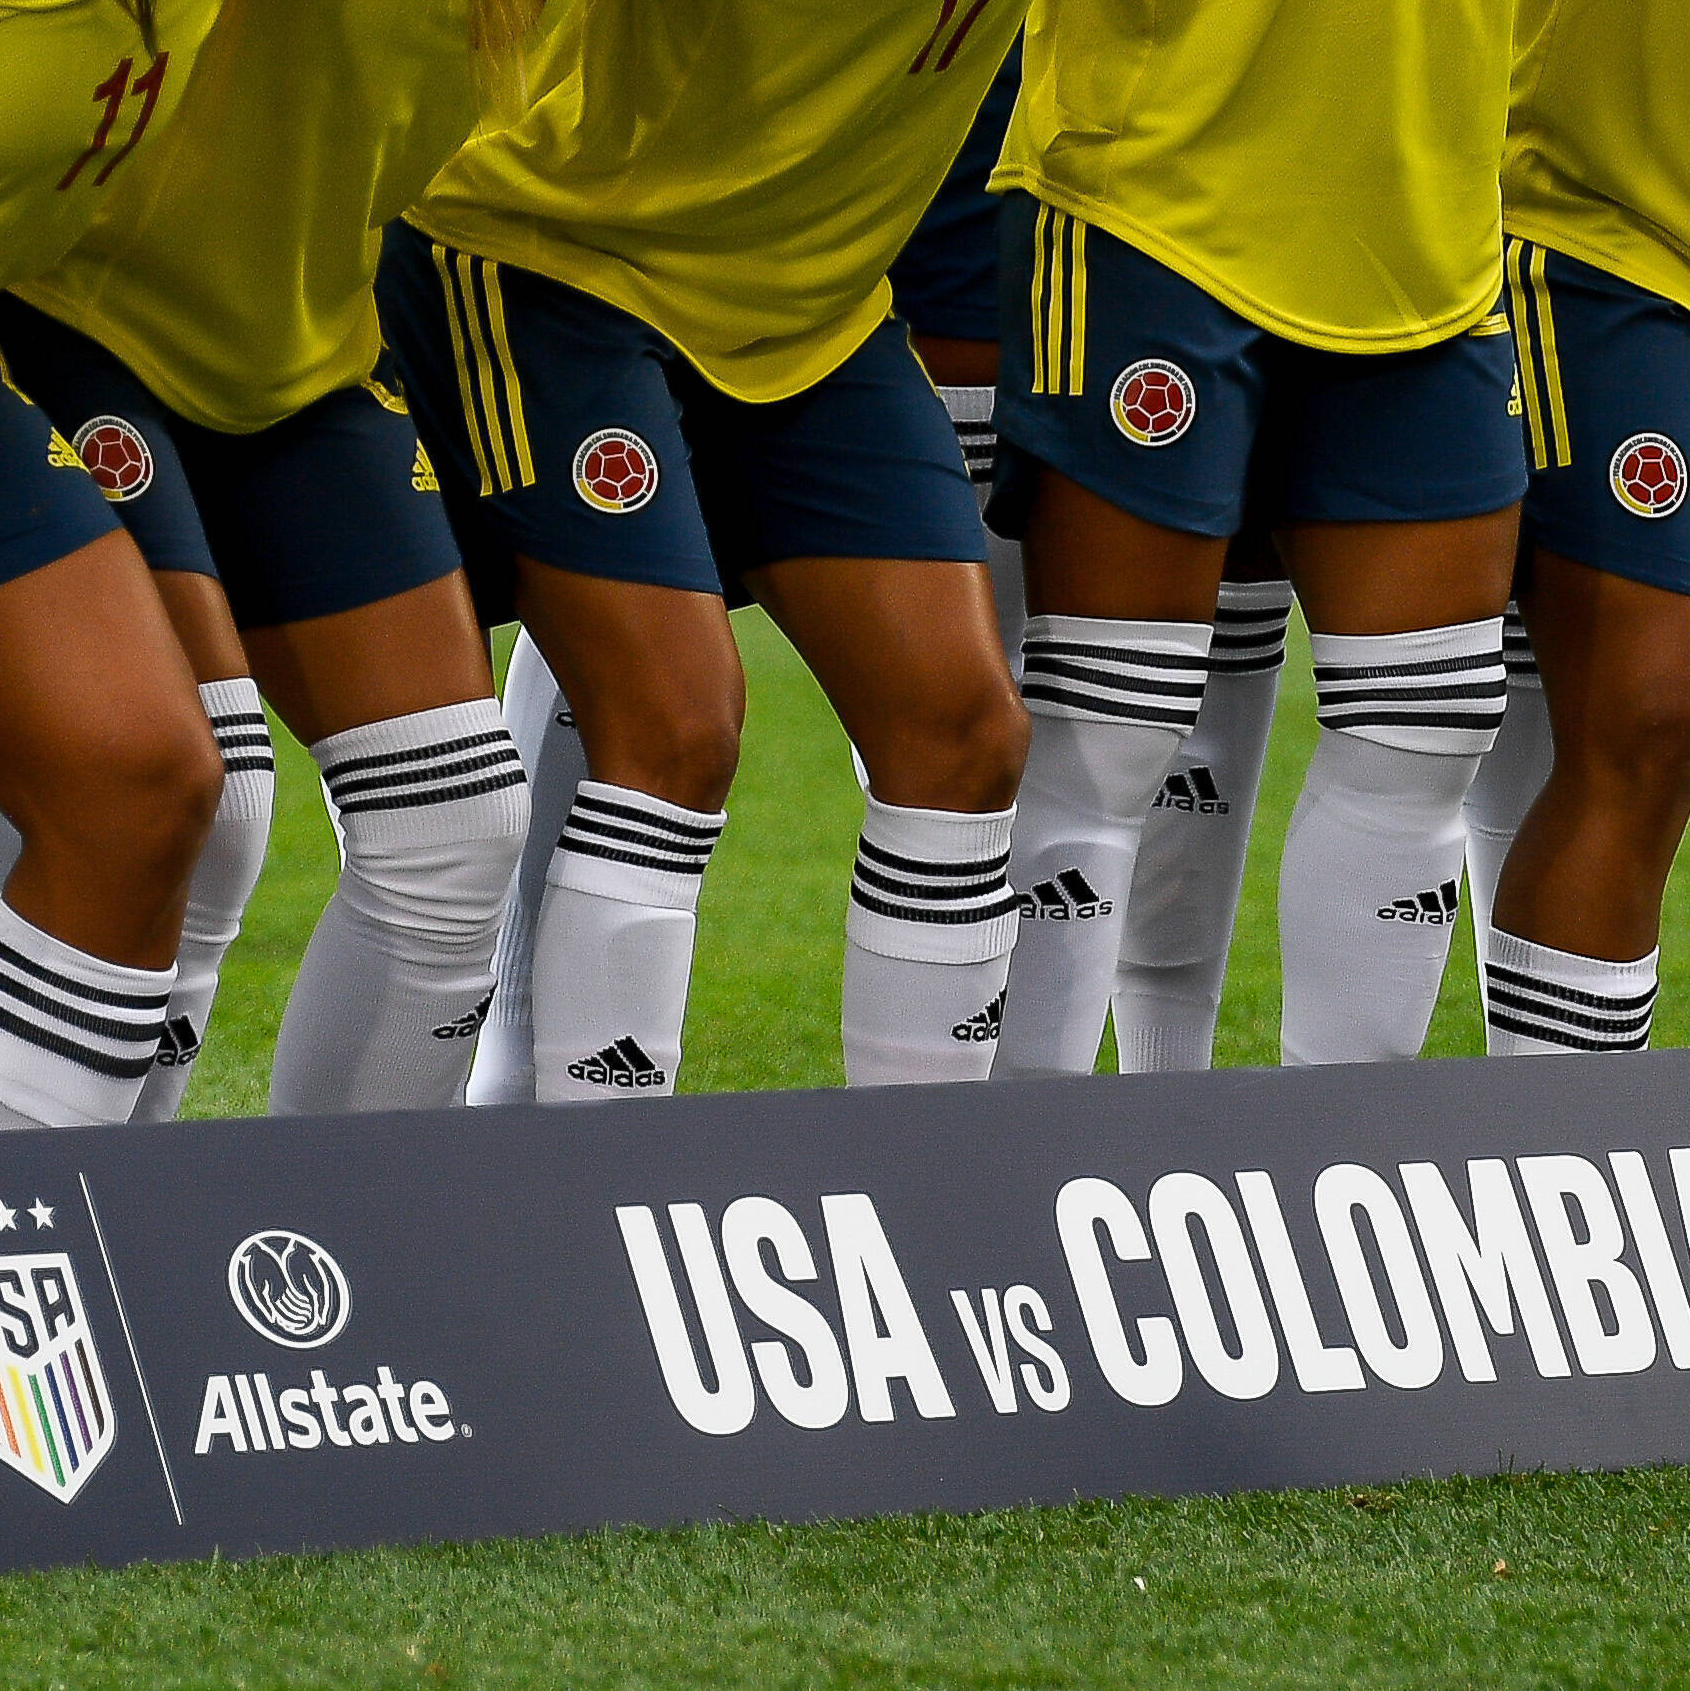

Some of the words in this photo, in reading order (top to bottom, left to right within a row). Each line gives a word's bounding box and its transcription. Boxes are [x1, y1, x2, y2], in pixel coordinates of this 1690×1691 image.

[56, 51, 169, 191] 11
[566, 1061, 666, 1089] adidas
[615, 1193, 956, 1435] USA
